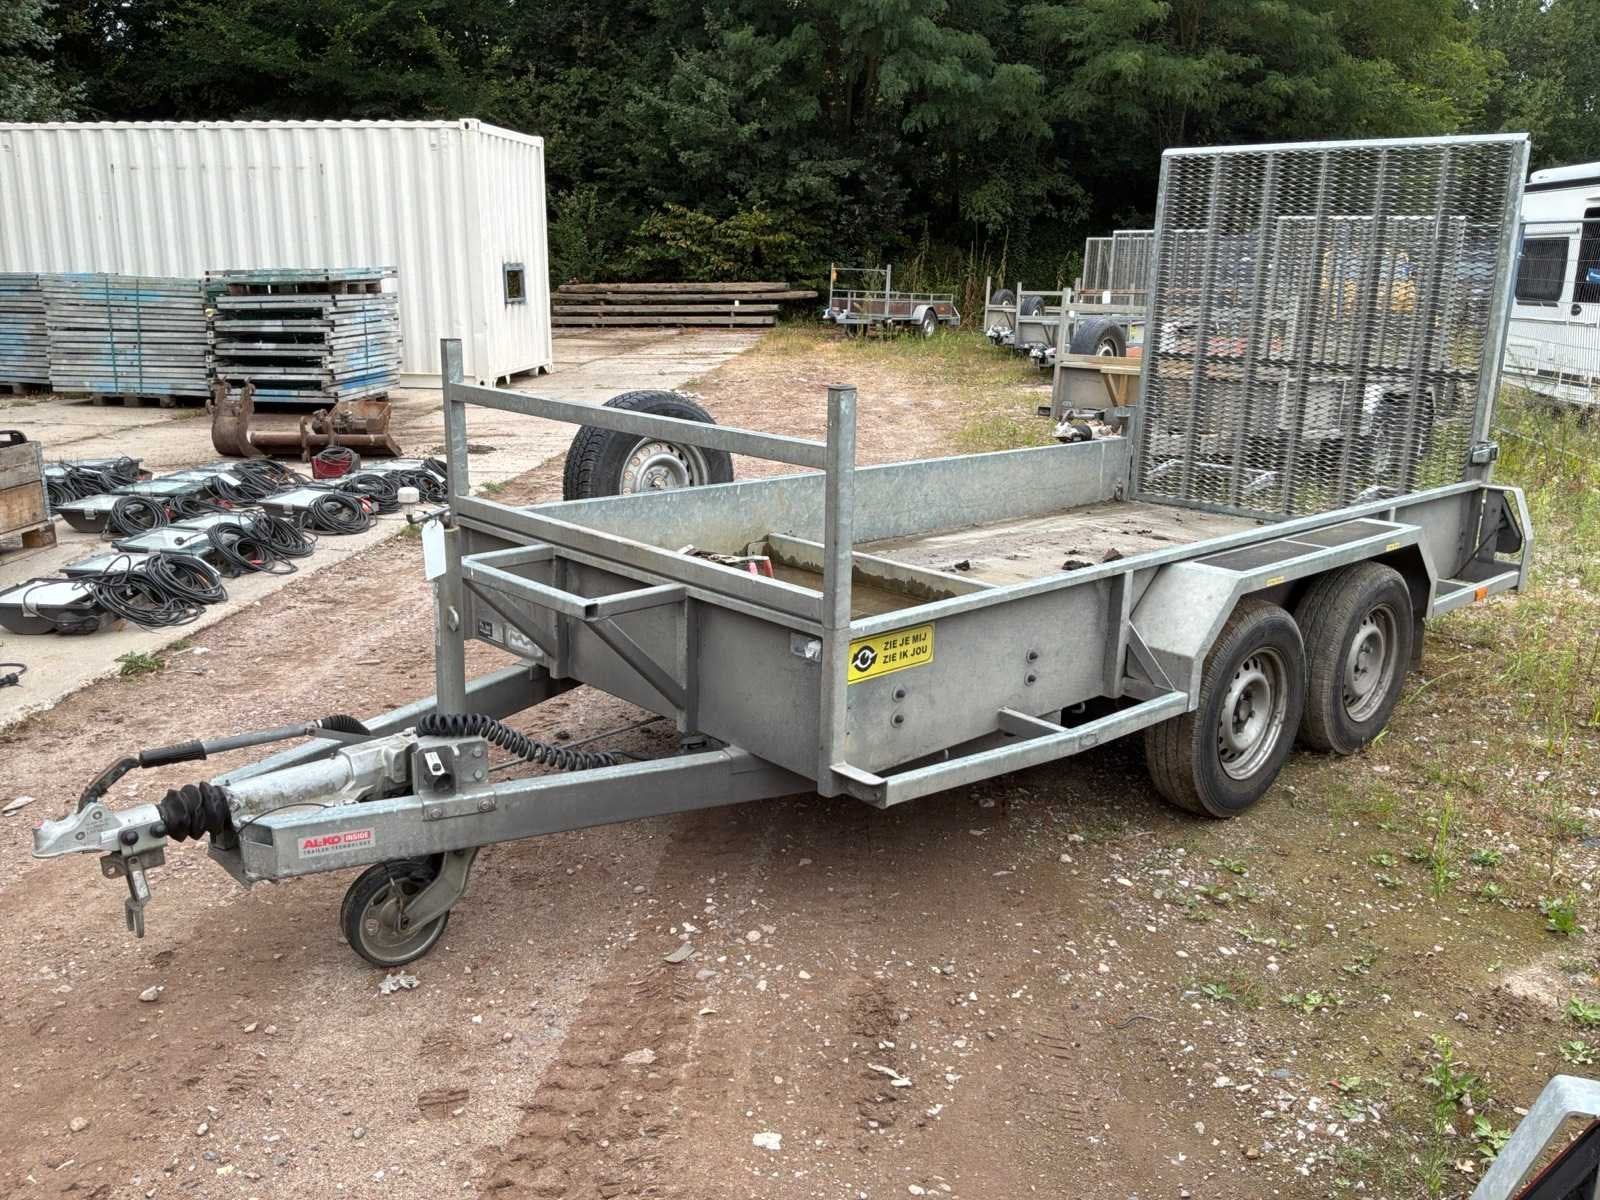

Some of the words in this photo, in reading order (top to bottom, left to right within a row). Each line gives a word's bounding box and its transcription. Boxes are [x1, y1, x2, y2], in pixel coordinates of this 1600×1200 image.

[884, 640, 898, 651] ZIE
[899, 636, 910, 646] JE
[912, 632, 927, 644] MIJ
[883, 652, 897, 664] ZIE
[899, 649, 908, 660] IK
[911, 645, 927, 657] JOU
[345, 831, 369, 841] INSIDE
